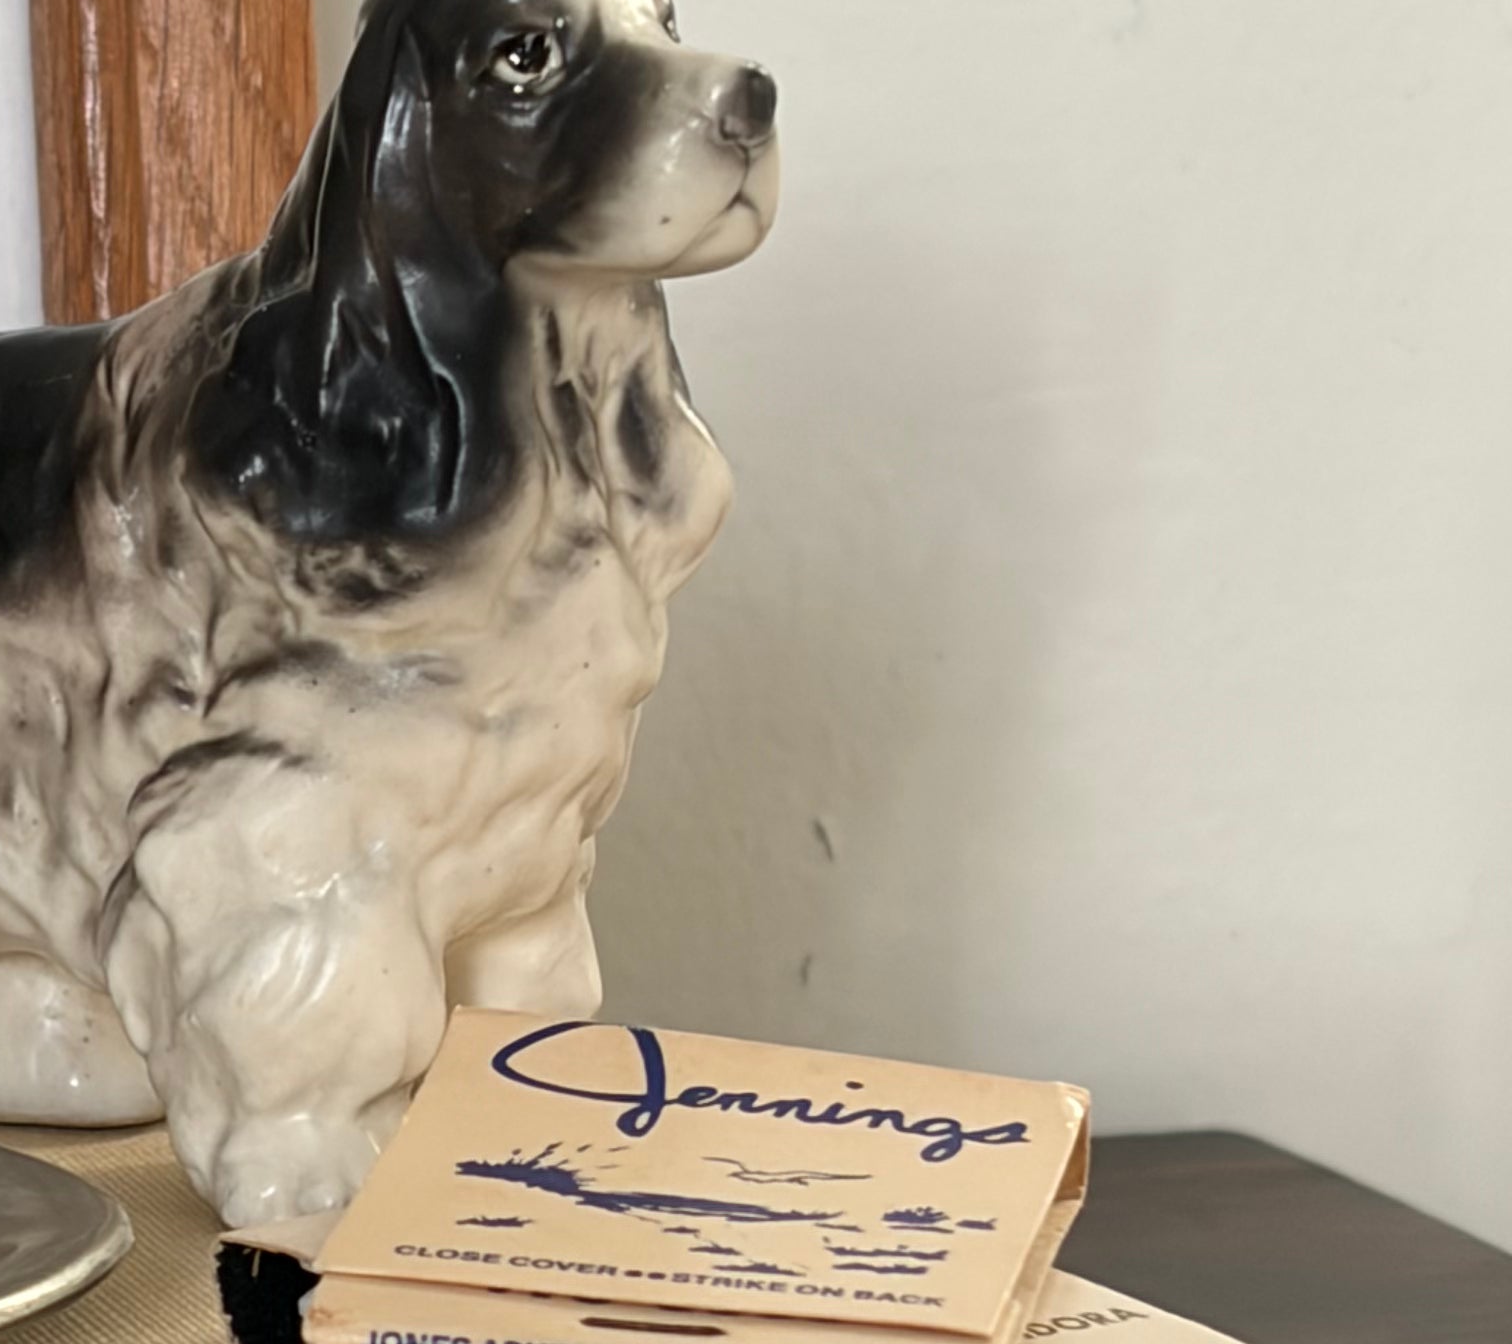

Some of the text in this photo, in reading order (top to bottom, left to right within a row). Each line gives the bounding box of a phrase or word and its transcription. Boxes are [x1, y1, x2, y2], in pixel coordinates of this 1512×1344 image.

[491, 1020, 1031, 1163] Jennings
[394, 1244, 945, 1308] CLOSE COVER STRIKE ON BACK
